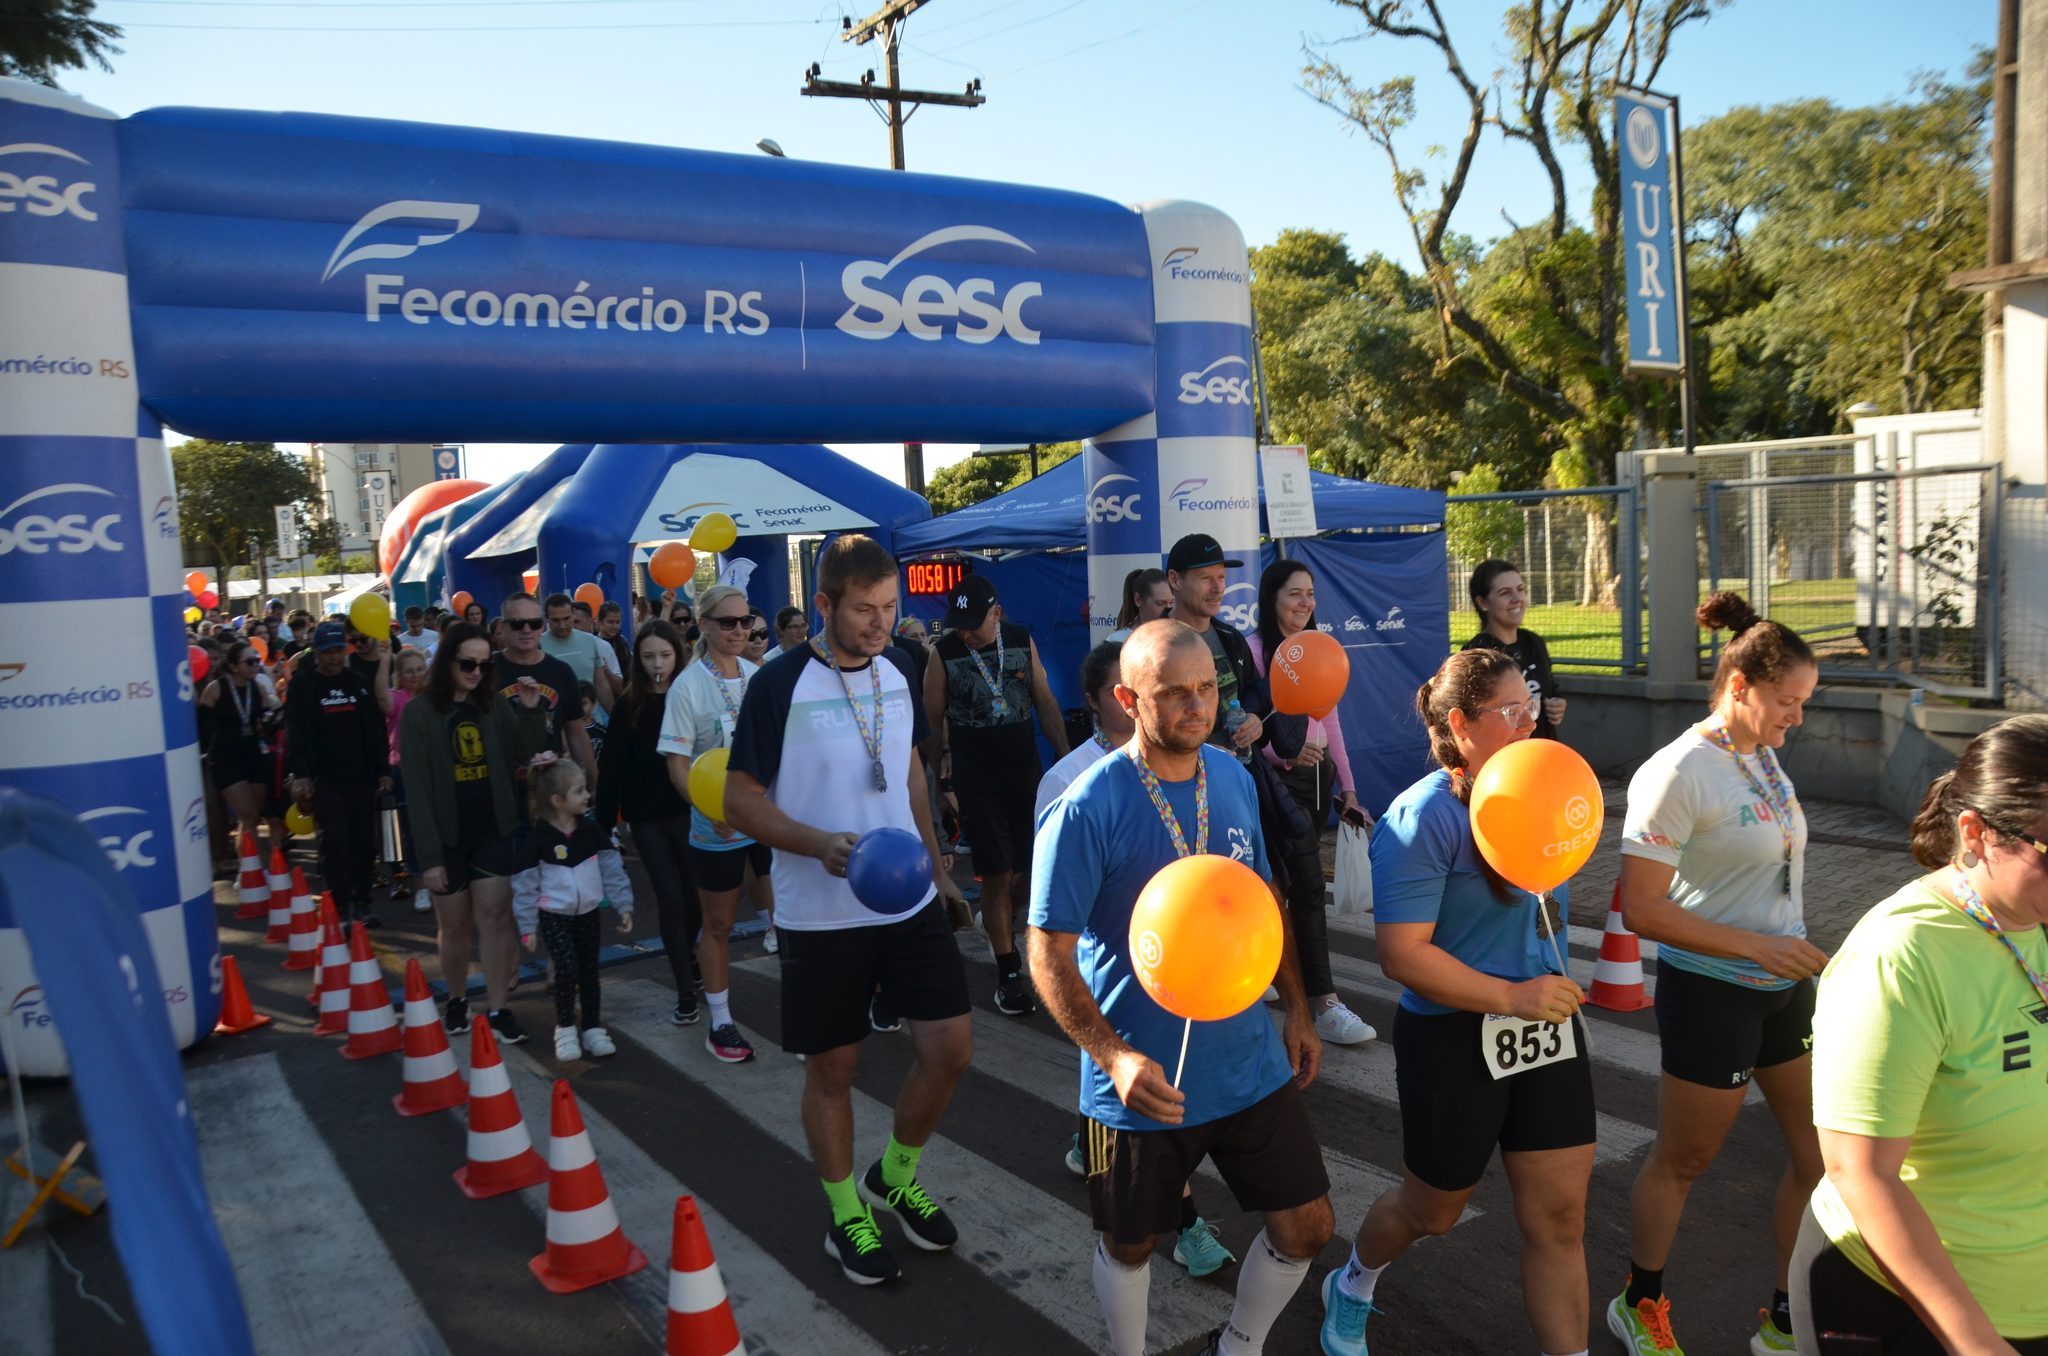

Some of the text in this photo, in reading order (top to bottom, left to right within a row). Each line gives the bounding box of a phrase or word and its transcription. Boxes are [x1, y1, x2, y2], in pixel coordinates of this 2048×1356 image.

[1632, 181, 1665, 357] URI
[364, 273, 770, 336] Fecomércio RS
[835, 259, 1042, 345] Sesc
[100, 359, 129, 378] RS
[755, 504, 832, 517] Fecomércio
[1179, 496, 1250, 511] Fecomércio
[763, 517, 806, 528] Senac
[127, 681, 154, 700] RS
[1495, 1020, 1562, 1070] 853
